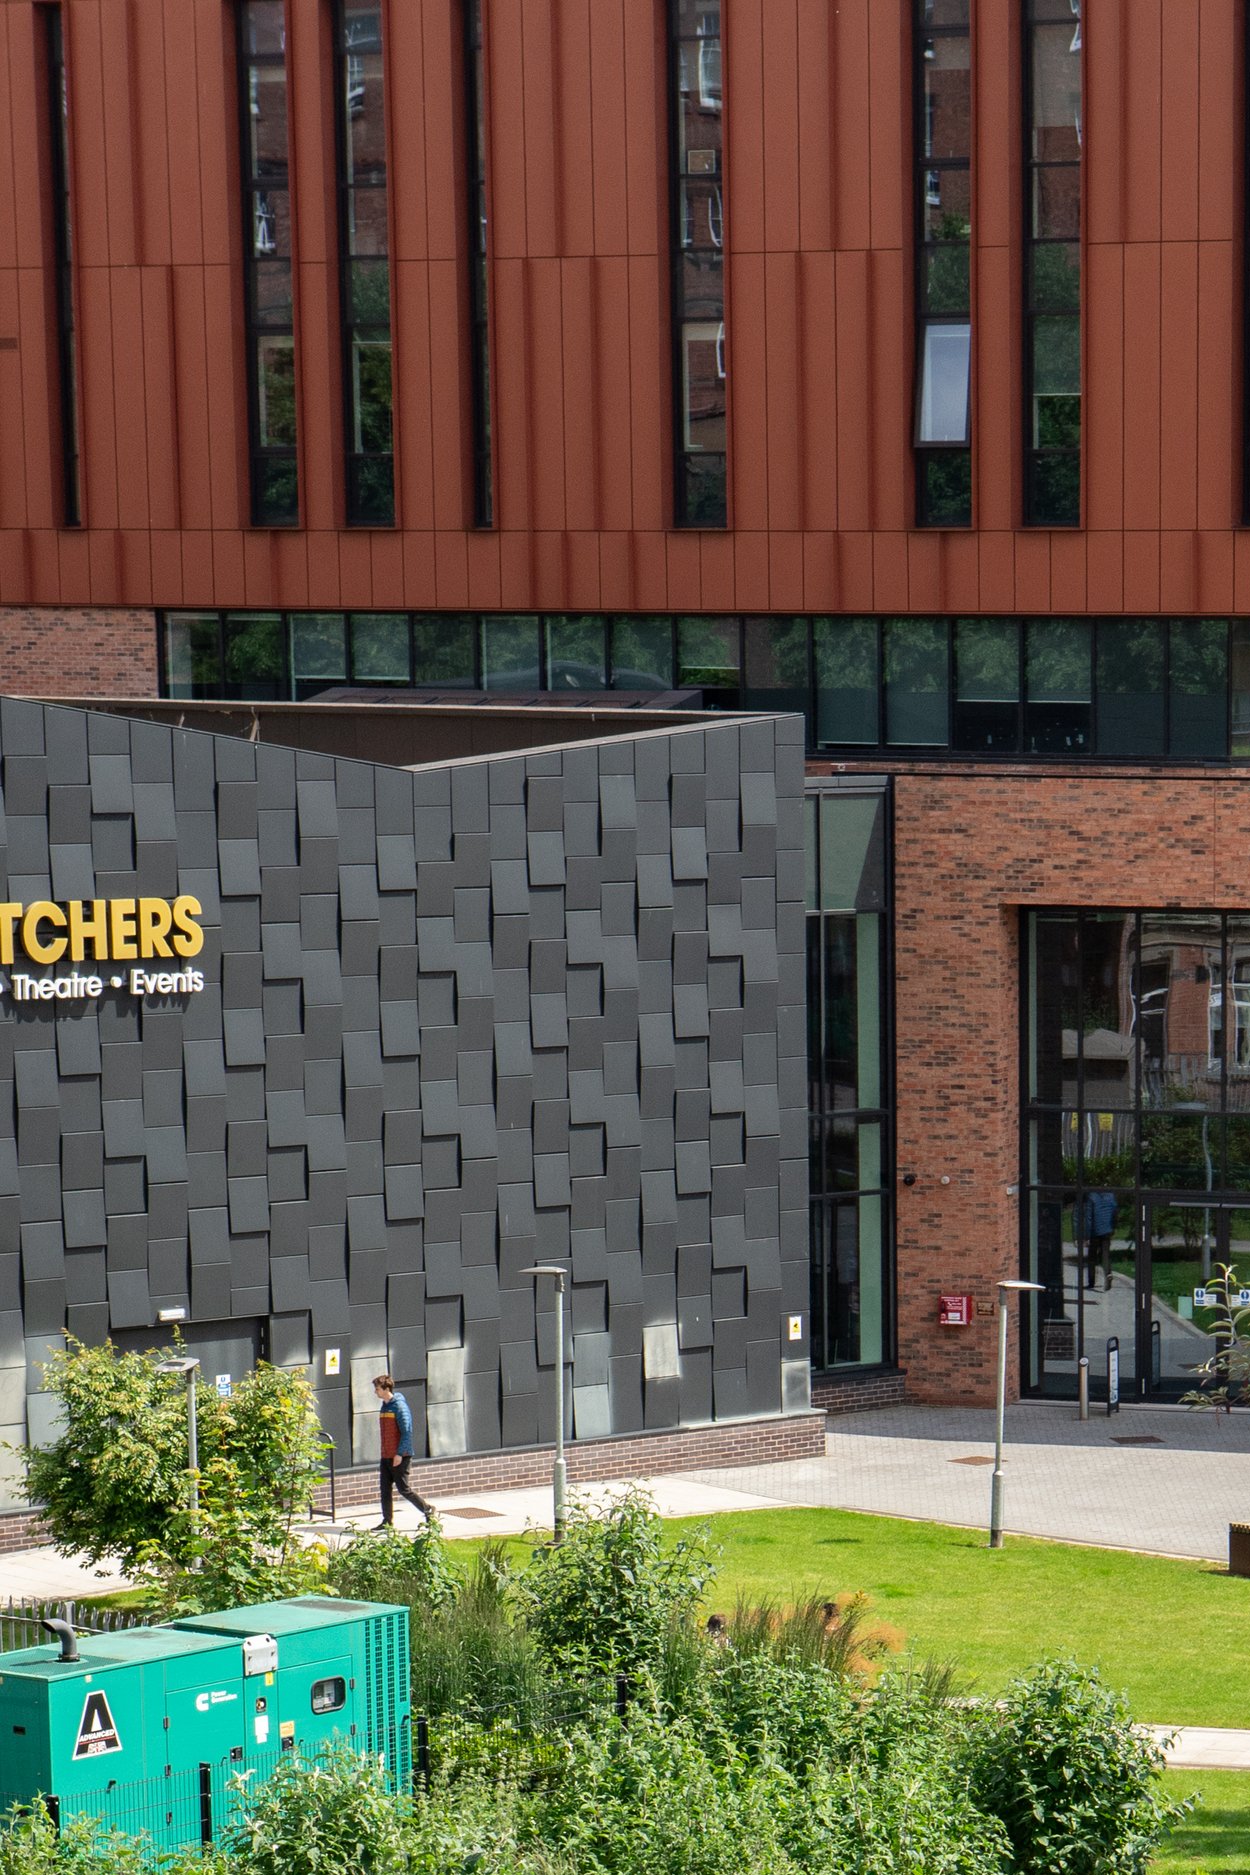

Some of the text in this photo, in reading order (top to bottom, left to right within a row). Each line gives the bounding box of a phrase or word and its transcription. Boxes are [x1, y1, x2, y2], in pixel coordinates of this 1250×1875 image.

[11, 966, 204, 1000] Theatre Events
[79, 1728, 116, 1742] ADVANCED
